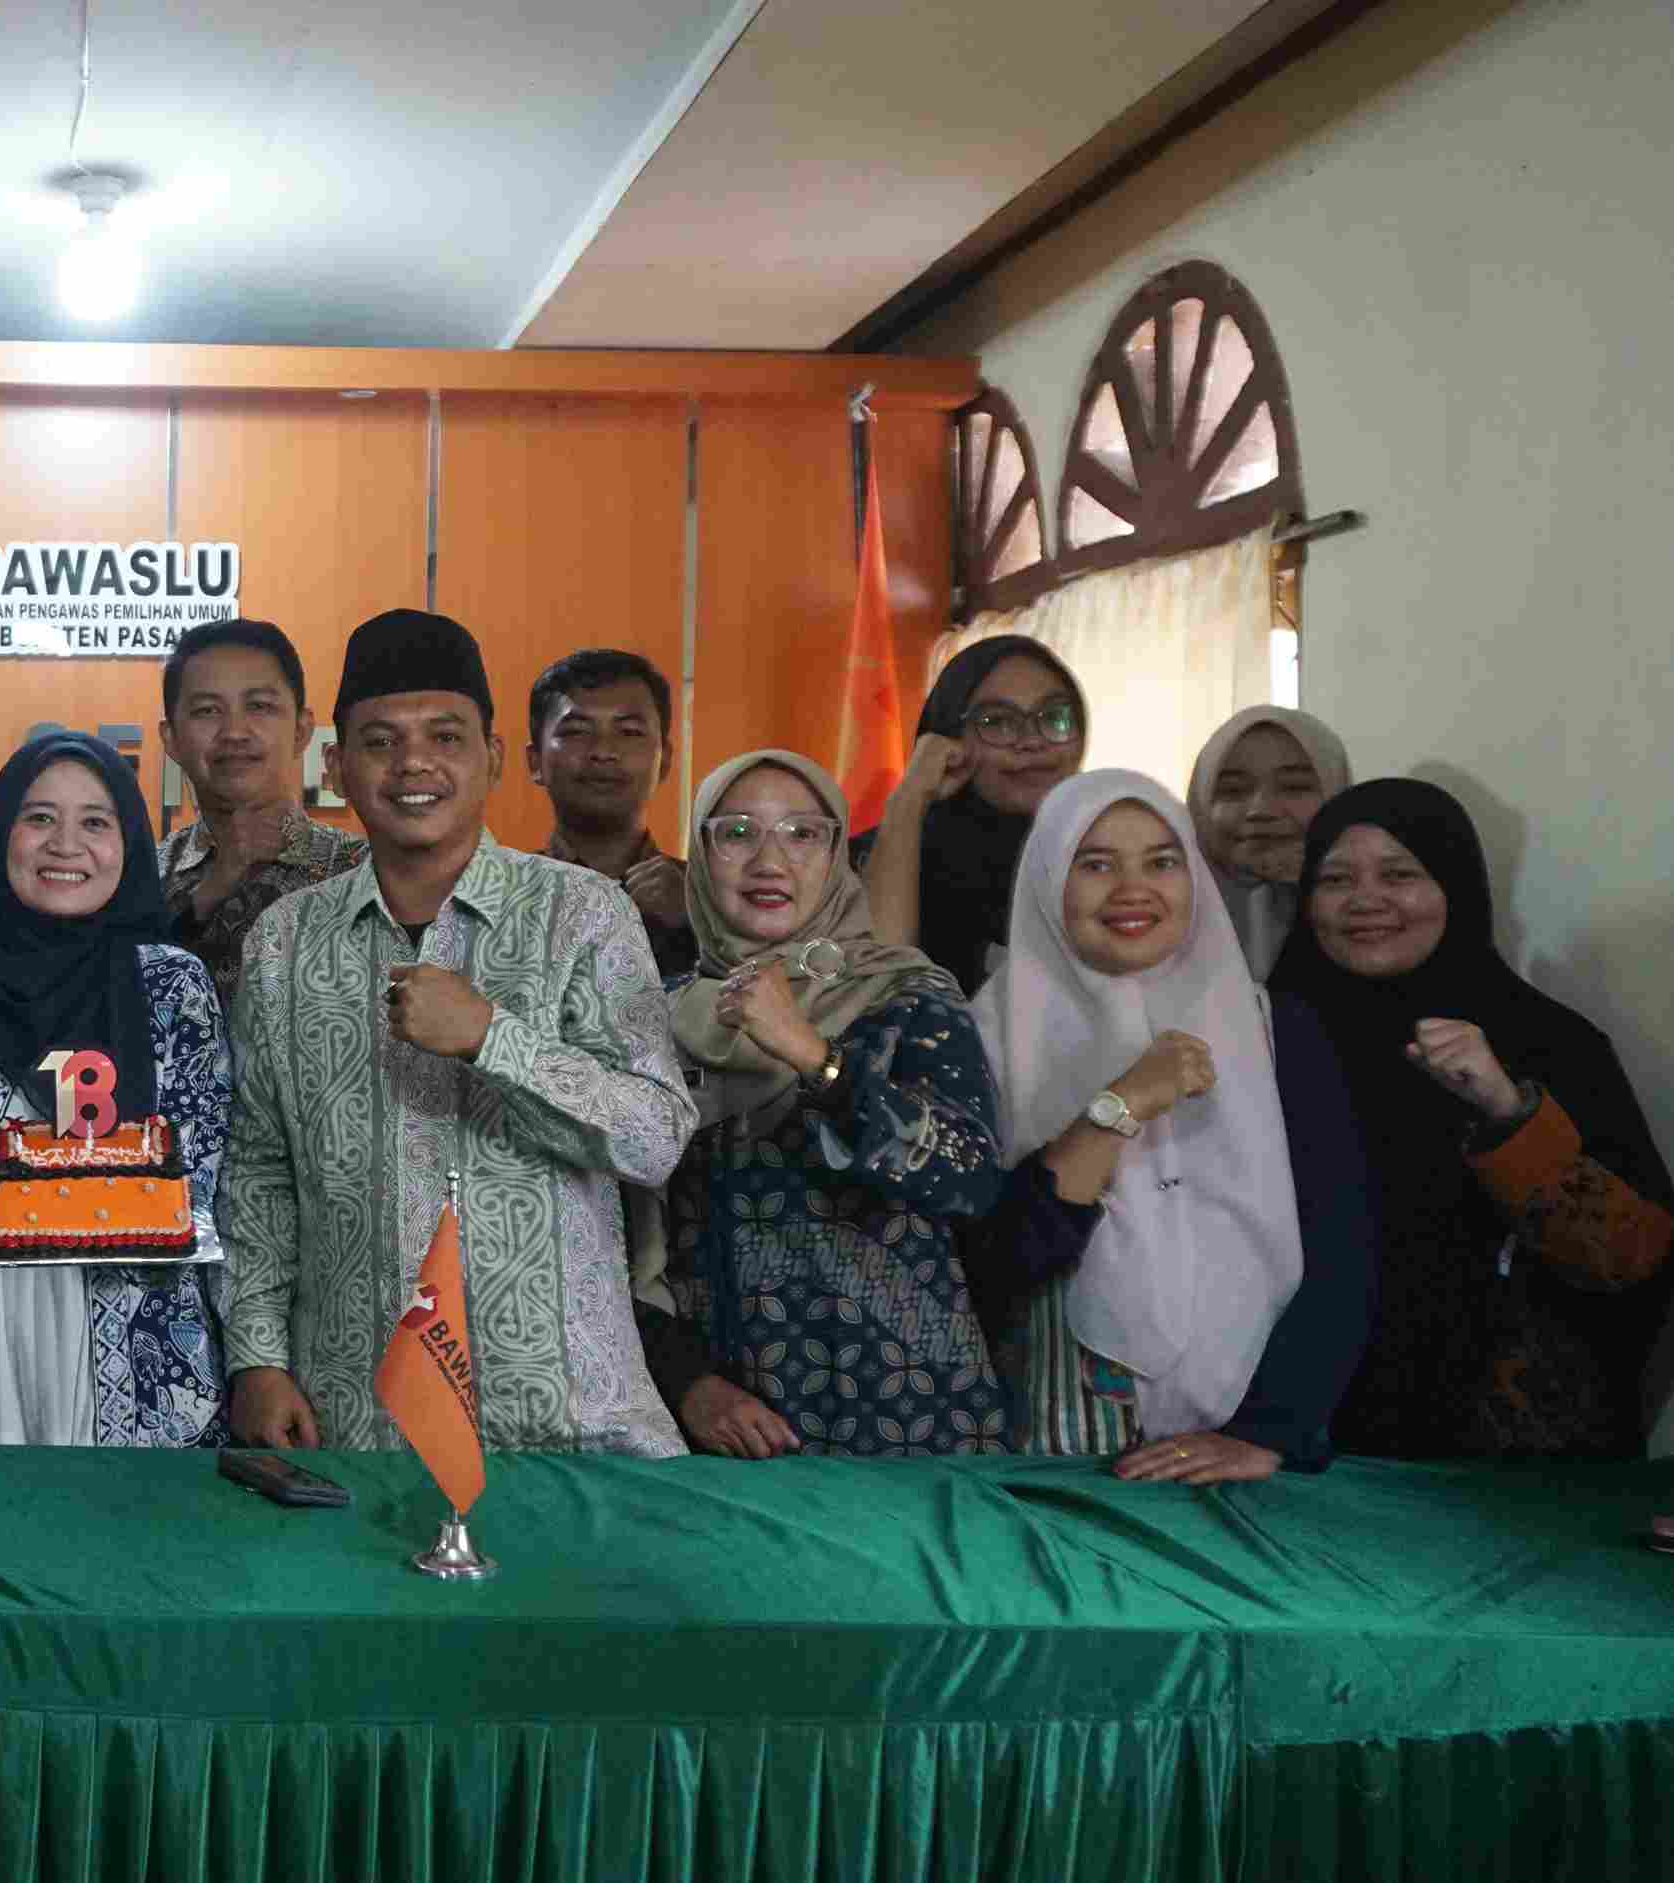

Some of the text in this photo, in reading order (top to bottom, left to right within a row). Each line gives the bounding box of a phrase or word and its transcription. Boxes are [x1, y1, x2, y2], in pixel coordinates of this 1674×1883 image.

[19, 603, 99, 619] PENGAWAS
[105, 604, 183, 620] PEMILIHAN
[188, 605, 232, 621] UMUM
[118, 626, 188, 648] PASA
[37, 1049, 118, 1139] 18
